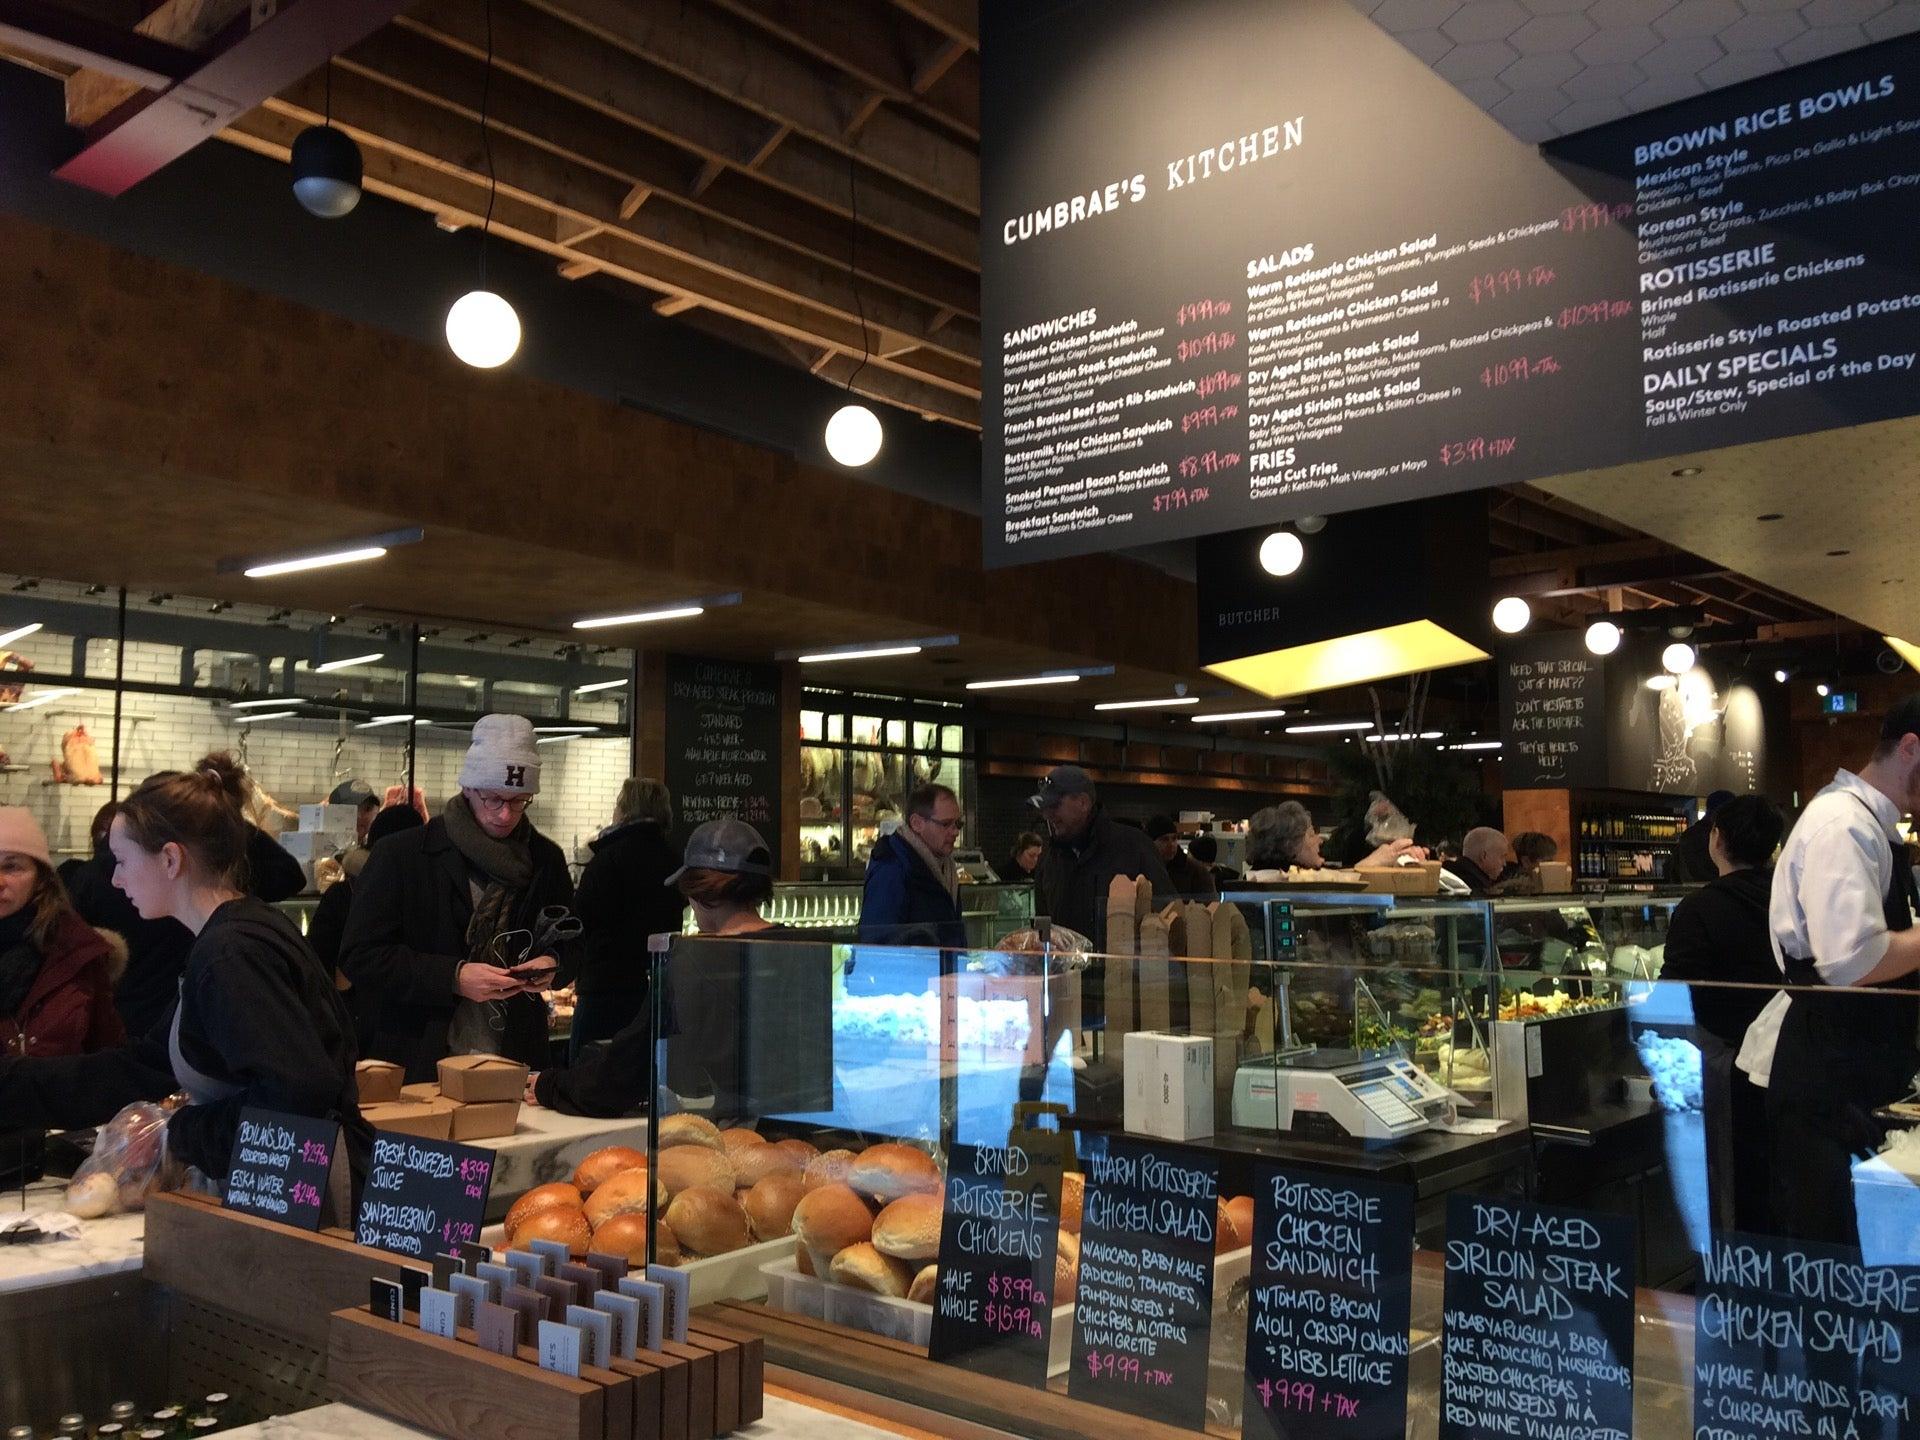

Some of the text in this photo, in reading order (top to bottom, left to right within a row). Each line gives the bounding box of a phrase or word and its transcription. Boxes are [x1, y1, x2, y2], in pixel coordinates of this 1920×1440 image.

[1634, 74, 1895, 166] BROWN RICE BOWLS
[1004, 116, 1304, 246] CUMBRAE'S KITCHEN
[1636, 148, 1748, 190] Mexican Style
[1638, 200, 1744, 238] Korean Style
[1247, 243, 1315, 278] SALADS
[1247, 234, 1437, 300] Warm Rotisserie Chicken Salad
[1640, 242, 1776, 293] ROTISSERIE
[1641, 254, 1866, 315] Brined Rotisserie Chickens
[1003, 308, 1097, 349] SANDWICHES
[1248, 280, 1438, 342] Warm Rotisserie Chicken Salad
[1641, 311, 1677, 326] Whole
[1003, 319, 1138, 366] Rotisserie Chicken Sandwich
[1642, 326, 1666, 342] Half
[1643, 334, 1724, 362] Rotisserie
[1728, 324, 1772, 346] Style
[1778, 305, 1852, 334] Roasted
[1004, 346, 1158, 396] Dry Aged Sirloin Steak Sandwich
[1248, 330, 1420, 384] Dry Aged Sirloin Steak Salad
[1644, 338, 1838, 394] DAILY SPECIALS
[1249, 377, 1420, 428] Dry Aged Sirloin Steak Salad
[1646, 352, 1916, 414] Soup/Stew, Special of the Day
[1004, 378, 1196, 435] French Braised Beef Short Rib Sandwich
[1678, 406, 1716, 422] Winter
[1720, 400, 1748, 416] Only
[1004, 418, 1173, 466] Buttermilk Fried Chicken Sandwich
[1250, 448, 1296, 472] FRIES
[1006, 462, 1168, 504] Smoked Peameal Bacon Sandwich
[1250, 462, 1338, 488] Hand Cut Fries
[1006, 506, 1098, 533] Breakfast Sandwich
[1218, 607, 1280, 626] BUTCHER
[505, 766, 526, 786] H
[374, 1140, 405, 1166] FRESH
[974, 1139, 1028, 1176] BRINED
[230, 1170, 254, 1188] ESKA
[372, 1166, 404, 1191] JUICE
[1092, 1149, 1216, 1199] WARM ROTISSERIE
[952, 1178, 1048, 1222] ROTISSERIE
[1090, 1190, 1212, 1242] CHICKEN SALAD
[1271, 1176, 1382, 1223] ROTISSERIE
[957, 1220, 1042, 1261] CHICKENS
[1277, 1213, 1362, 1254] CHICKEN
[1473, 1204, 1600, 1250] DRY-AGED
[943, 1268, 972, 1294] HALF
[1142, 1248, 1173, 1274] BABY
[1266, 1241, 1380, 1293] SANDWICH
[1446, 1240, 1628, 1299] SIRLOIN STEAK
[1701, 1240, 1920, 1313] WARM ROTISSERIE
[940, 1294, 978, 1322] WHOLE
[1080, 1285, 1164, 1317] PUMPKIN SEEDS
[1330, 1293, 1380, 1323] BACON
[1484, 1281, 1574, 1321] SALAD
[1084, 1327, 1156, 1356] VINAIGRETTE
[1136, 1319, 1187, 1344] IN CITRUS
[1304, 1319, 1408, 1356] CRISPY ONIONS
[1568, 1332, 1608, 1360] BABY
[1701, 1292, 1901, 1364] CHICKEN SALAD
[1280, 1344, 1392, 1385] BIBB LETTUCE
[1444, 1353, 1498, 1384] ROASTED
[1444, 1380, 1598, 1425] PUMPKIN SEEDS IN A
[1446, 1404, 1520, 1435] RED WINE
[1719, 1395, 1812, 1435] CURRANTS
[1818, 1416, 1836, 1440] IN
[1844, 1419, 1860, 1440] A
[1858, 1390, 1910, 1421] PARM
